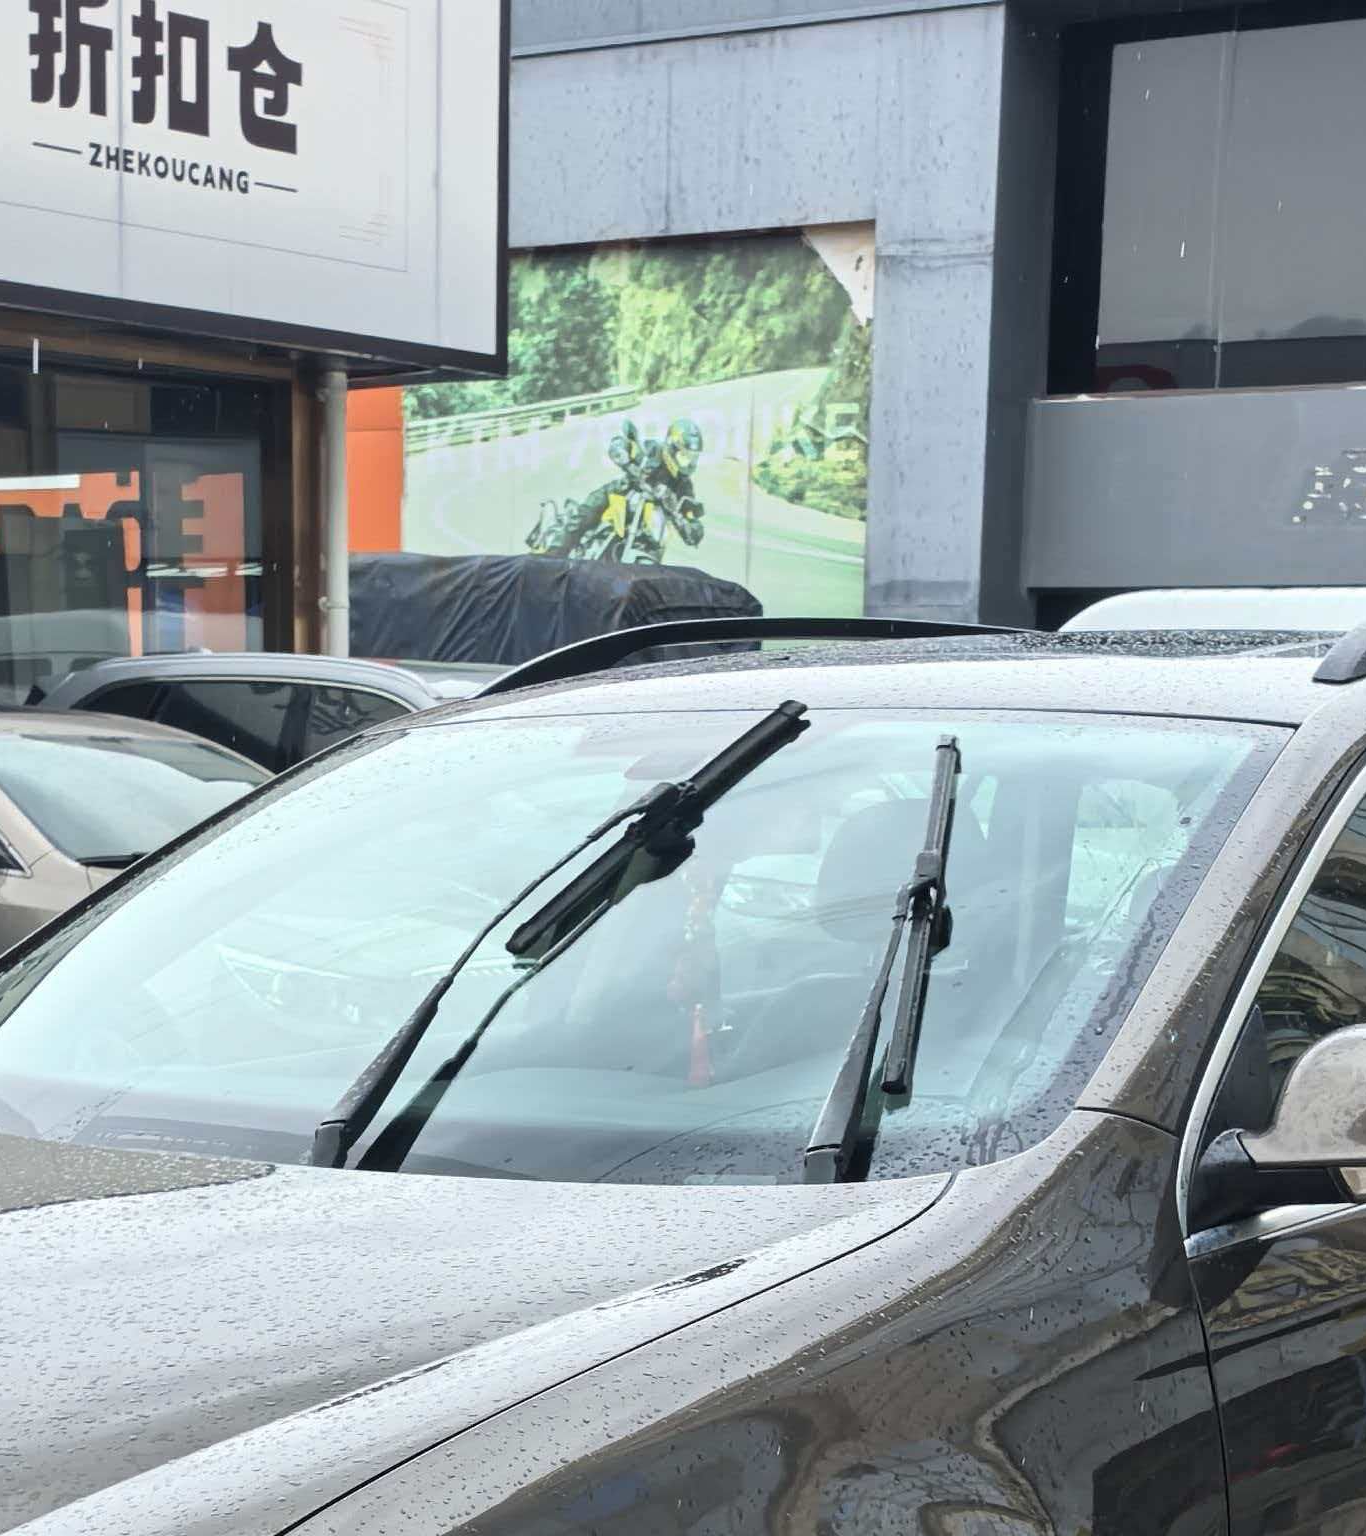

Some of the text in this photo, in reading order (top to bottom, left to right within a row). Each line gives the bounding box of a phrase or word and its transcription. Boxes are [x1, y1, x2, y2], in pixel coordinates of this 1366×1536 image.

[28, 0, 303, 155] 折扣仓
[88, 141, 250, 194] ZHEKOUCANG
